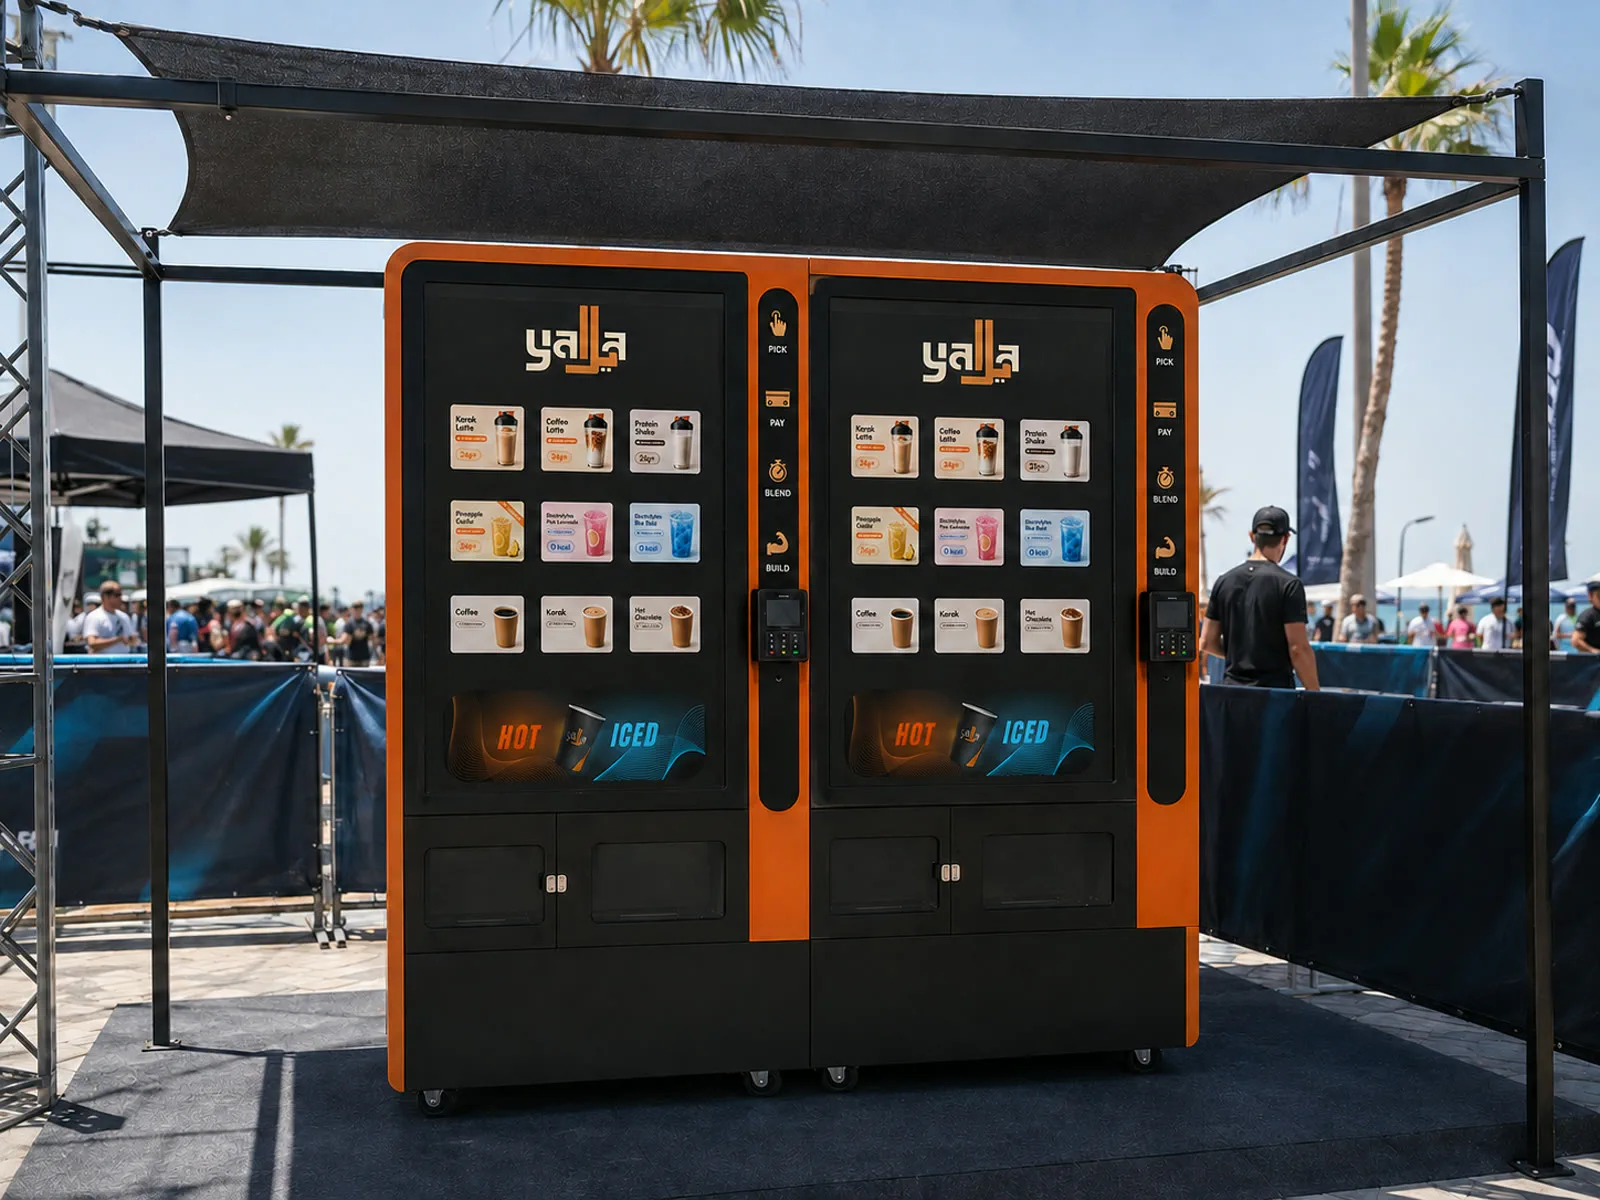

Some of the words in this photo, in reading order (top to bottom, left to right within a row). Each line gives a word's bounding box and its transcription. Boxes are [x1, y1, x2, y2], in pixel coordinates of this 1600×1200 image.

[526, 305, 626, 374] yalla
[768, 345, 788, 353] PICK
[923, 319, 1019, 385] yalla
[1156, 358, 1174, 366] PICK
[545, 417, 569, 426] Coffee
[634, 420, 659, 428] Protein
[769, 419, 785, 427] PAY
[634, 428, 655, 436] Shake
[939, 427, 961, 435] Coffee
[1024, 429, 1048, 437] Protein
[1157, 428, 1173, 436] PAY
[1024, 437, 1045, 445] Shake
[764, 488, 792, 497] BLEND
[1153, 495, 1179, 503] BLEND
[765, 564, 790, 572] BUILD
[1153, 568, 1177, 576] BUILD
[455, 608, 479, 616] Coffee
[855, 609, 877, 618] Coffee
[610, 722, 659, 748] ICED
[895, 721, 936, 746] HOT
[1002, 719, 1050, 745] ICED
[497, 724, 543, 750] HOT
